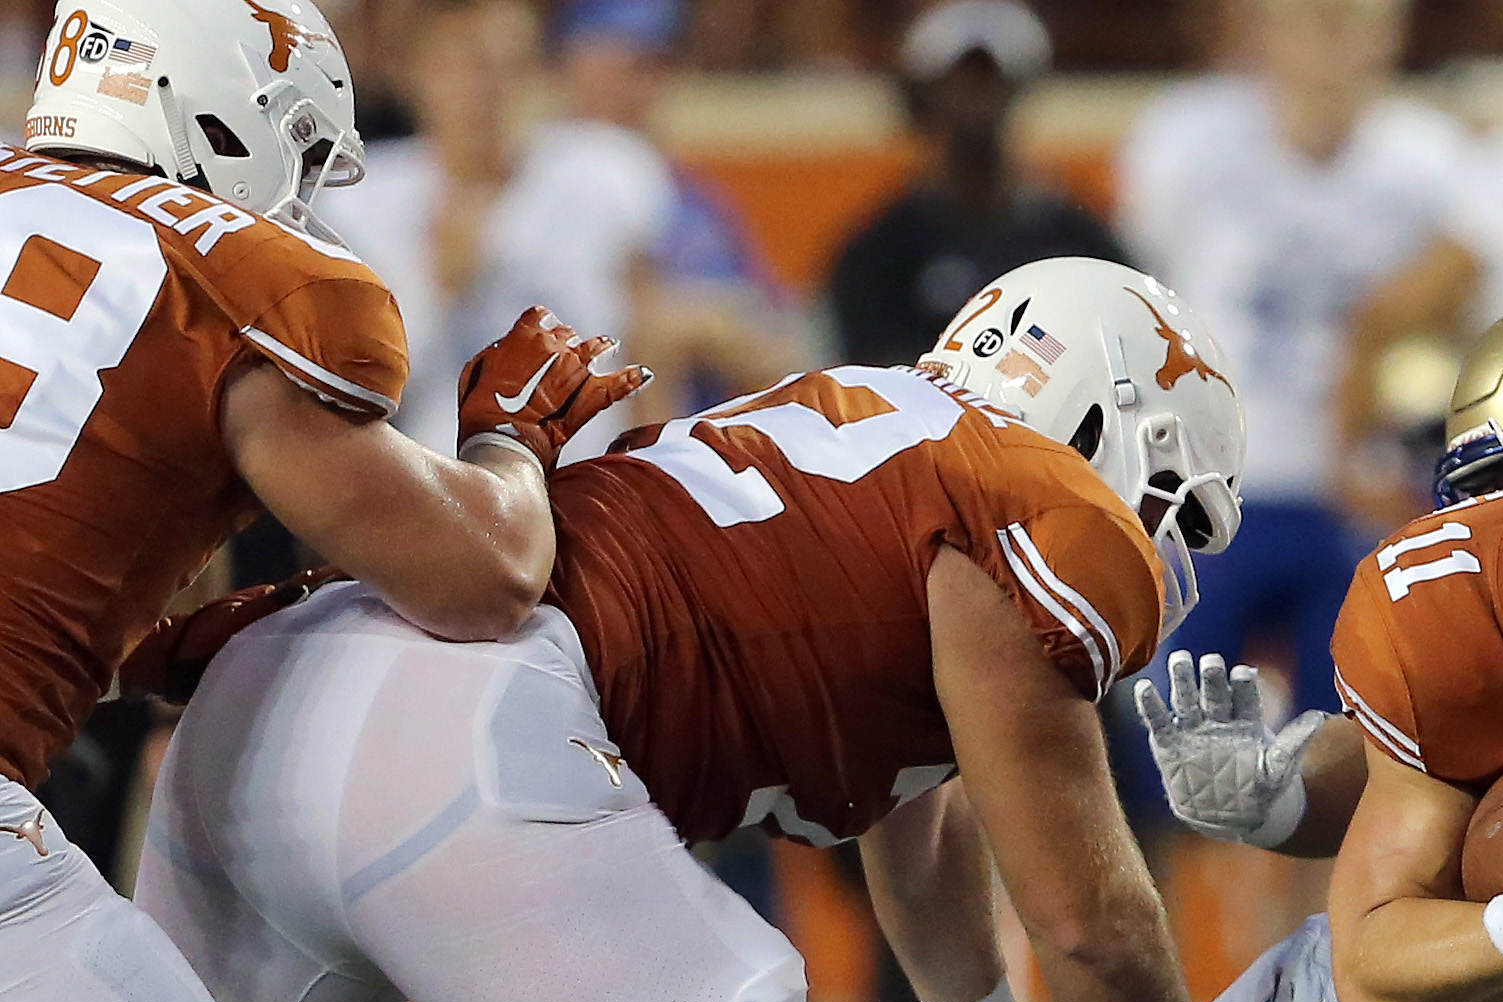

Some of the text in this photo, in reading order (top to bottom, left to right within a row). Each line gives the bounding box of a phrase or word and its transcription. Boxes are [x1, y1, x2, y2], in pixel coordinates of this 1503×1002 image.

[80, 36, 108, 61] FD
[974, 329, 1002, 356] FD
[1376, 521, 1482, 602] 11
